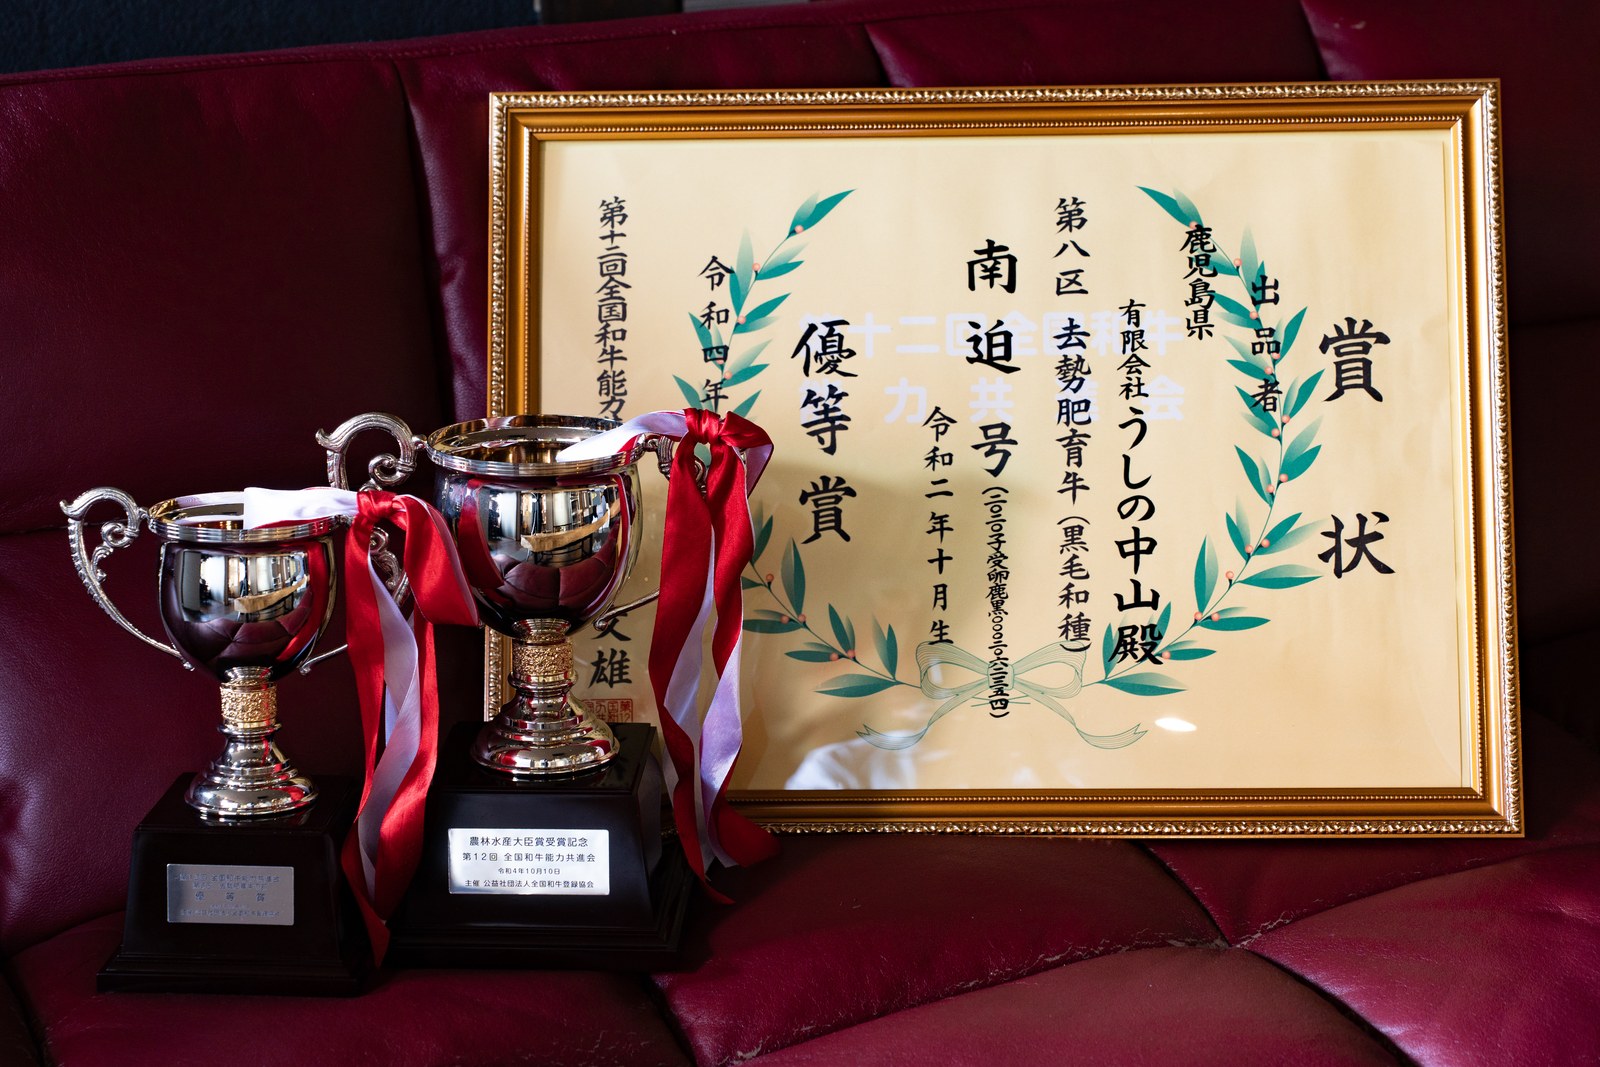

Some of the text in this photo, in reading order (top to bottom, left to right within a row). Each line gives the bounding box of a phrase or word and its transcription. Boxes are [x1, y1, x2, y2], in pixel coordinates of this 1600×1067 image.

[594, 196, 632, 421] 第十二回全国和牛能力
[1179, 223, 1219, 341] 鹿児島県
[1251, 274, 1284, 415] 出品者
[790, 319, 859, 546] 優等賞
[1053, 196, 1092, 653] 第八区 去勢肥育牛（黒毛和種）
[1317, 316, 1395, 579] 賞状
[921, 405, 958, 646] 令和二年十月生
[462, 852, 596, 863] 第12回 全国和牛能力共進会
[464, 879, 594, 888] 主催 公益社団法人全国和牛登録協会
[469, 836, 589, 847] 農林水産大臣賞受賞記念
[498, 867, 561, 875] 令和4年10月10日
